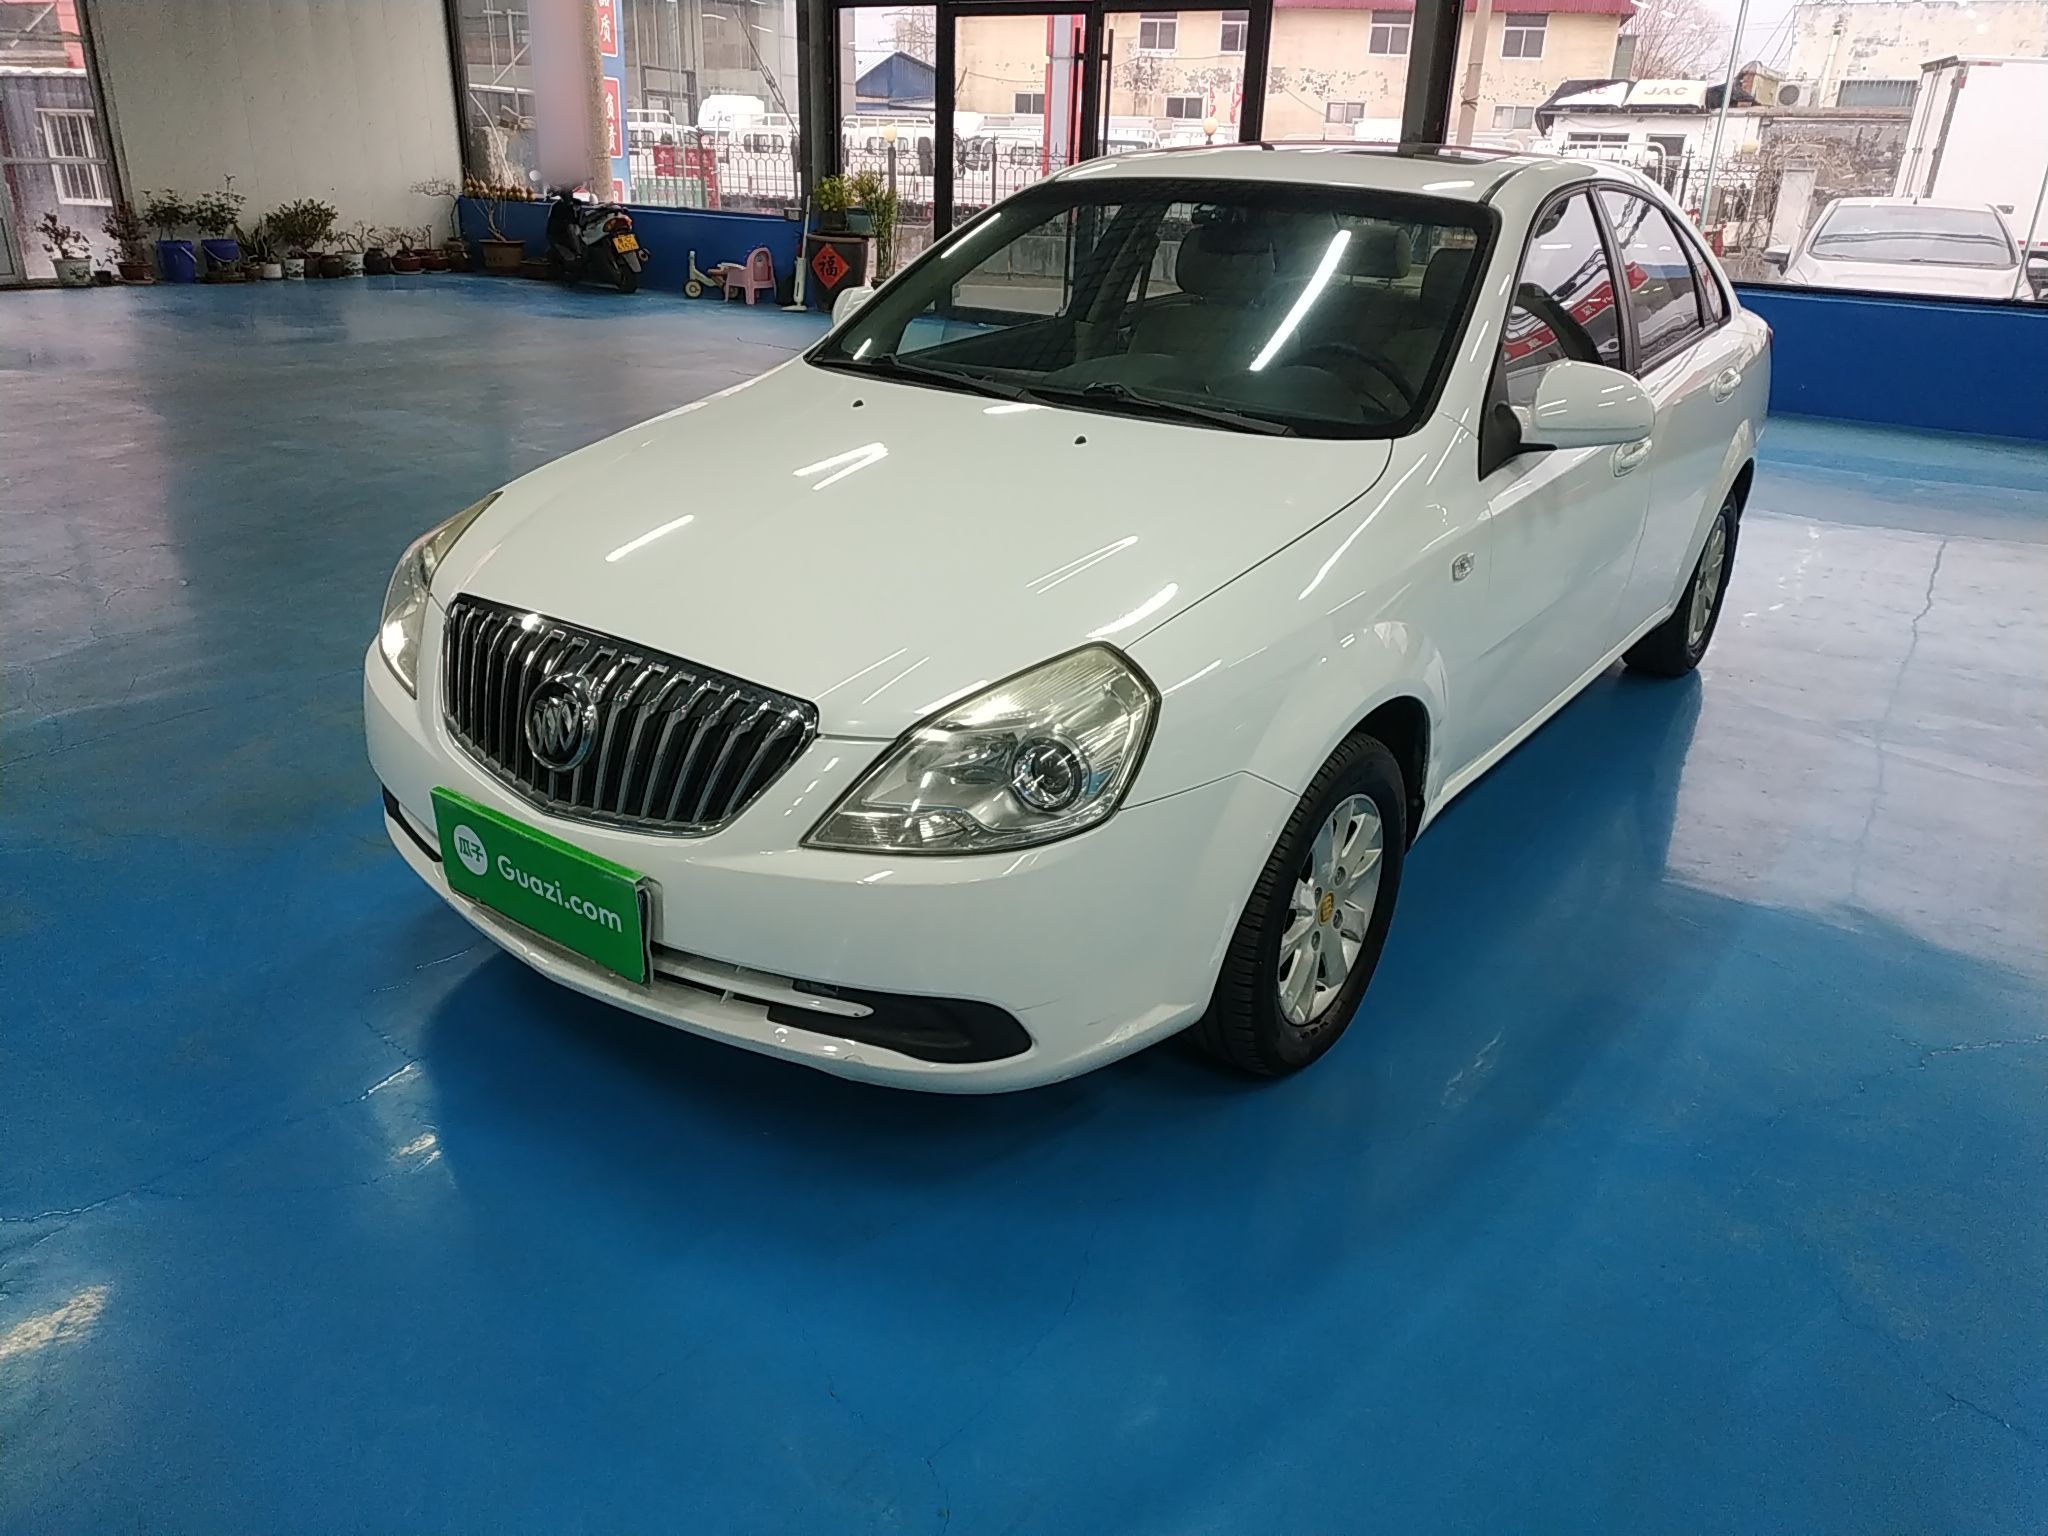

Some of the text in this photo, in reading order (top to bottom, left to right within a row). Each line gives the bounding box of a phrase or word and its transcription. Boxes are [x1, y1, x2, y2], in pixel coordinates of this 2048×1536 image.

[1644, 86, 1688, 96] JAC
[819, 255, 838, 277] 福
[458, 836, 485, 863] 瓜子
[497, 855, 623, 933] Guazi.com
